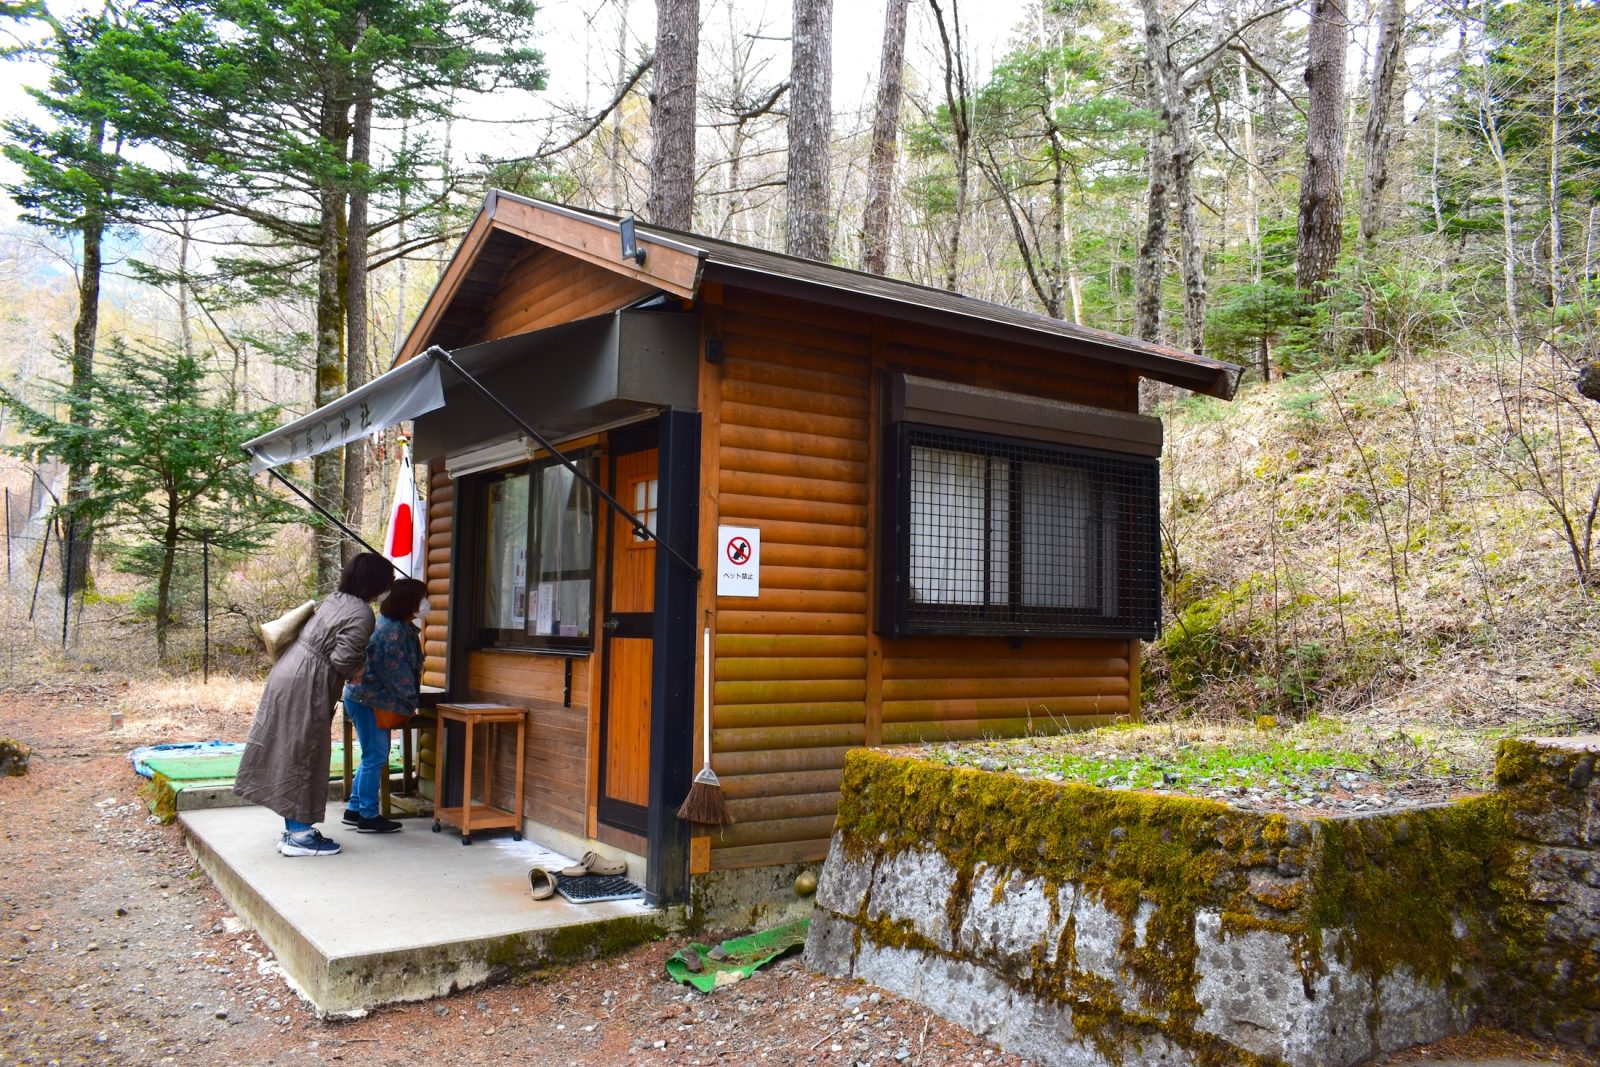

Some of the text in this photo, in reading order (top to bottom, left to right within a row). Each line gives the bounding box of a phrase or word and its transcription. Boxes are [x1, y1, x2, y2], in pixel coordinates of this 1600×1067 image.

[723, 572, 754, 580] ペット禁止
